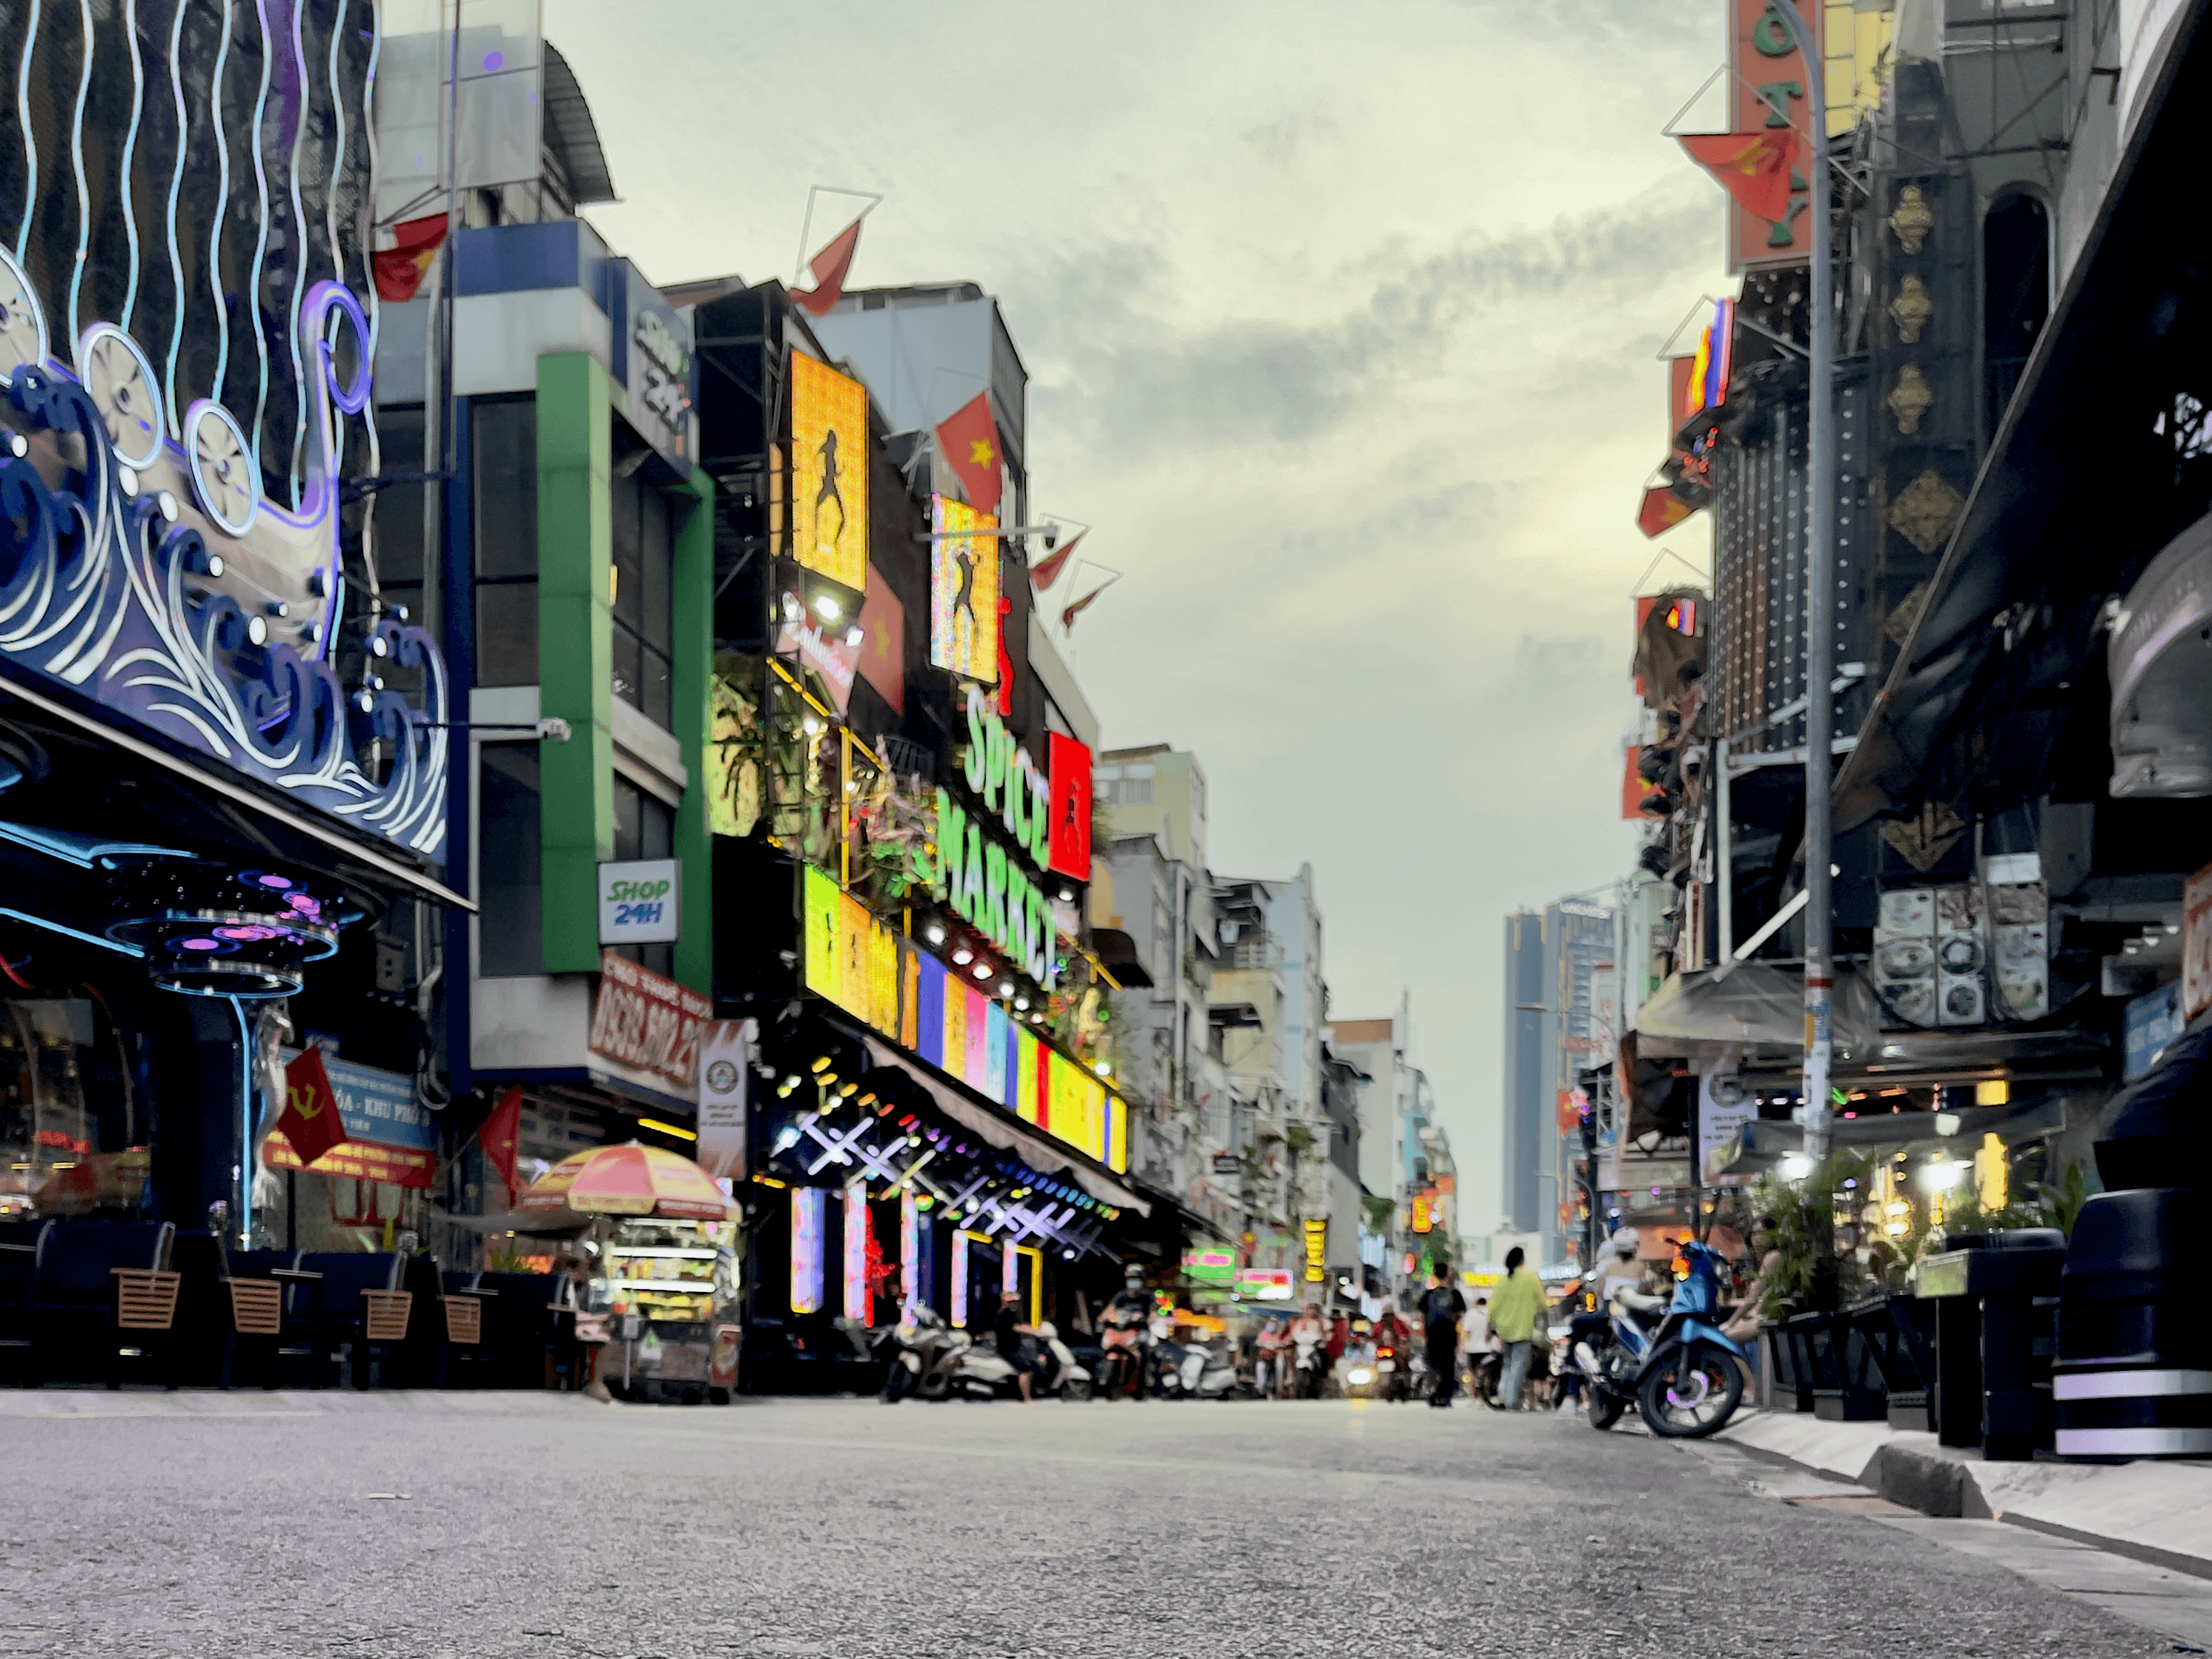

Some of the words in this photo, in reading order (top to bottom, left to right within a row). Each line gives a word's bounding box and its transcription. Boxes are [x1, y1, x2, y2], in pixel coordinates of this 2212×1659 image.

[964, 682, 1050, 872] SPICE
[606, 879, 670, 901] SHOP
[613, 901, 664, 926] 24H
[936, 784, 1056, 993] MARKET
